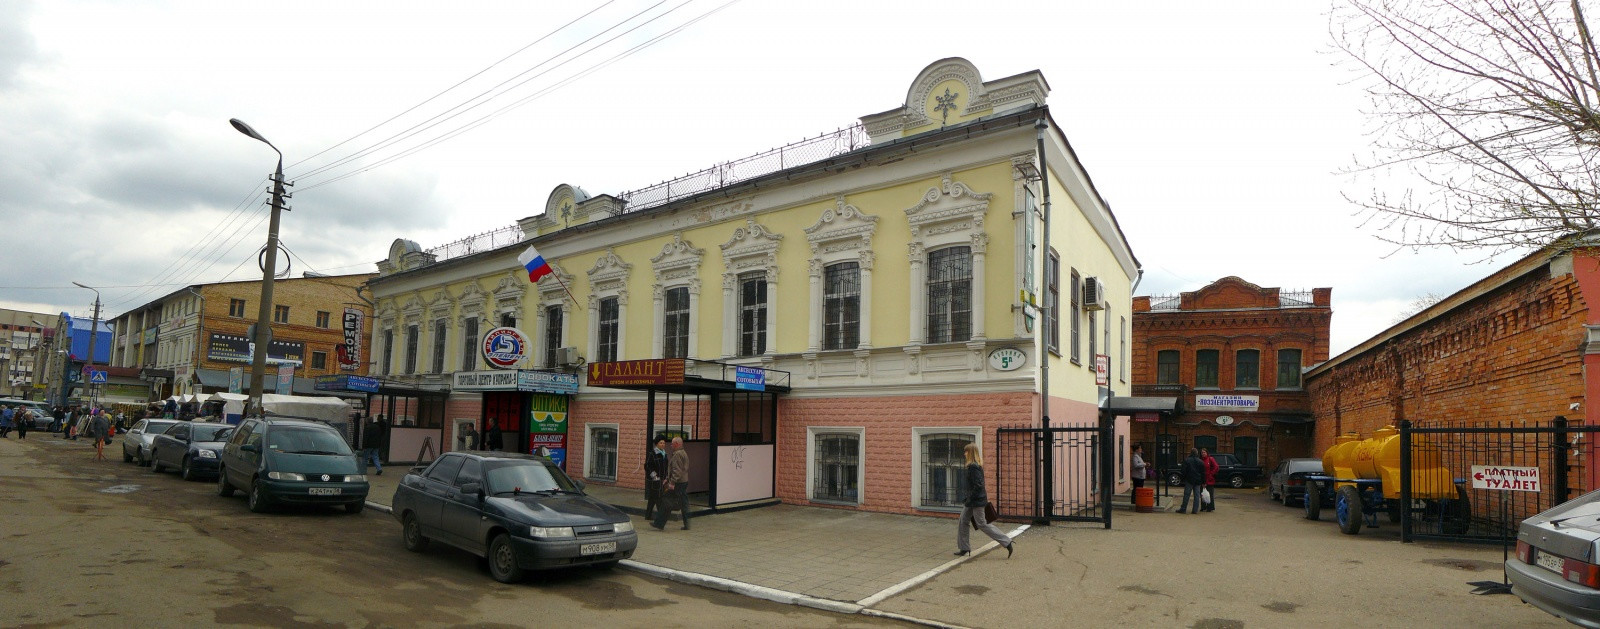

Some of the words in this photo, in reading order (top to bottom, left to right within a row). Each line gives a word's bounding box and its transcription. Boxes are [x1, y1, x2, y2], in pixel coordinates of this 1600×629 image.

[345, 313, 356, 360] РЕМОНТ
[487, 352, 526, 360] ЭЛЕМЕНТ
[605, 361, 665, 376] ГАЛАНТ
[519, 372, 577, 384] АДВОКАТЫ
[532, 394, 567, 412] ОПТИКА
[1485, 468, 1537, 478] ПЛАТНЫЙ
[1485, 479, 1537, 490] ТУАЛЕТ
